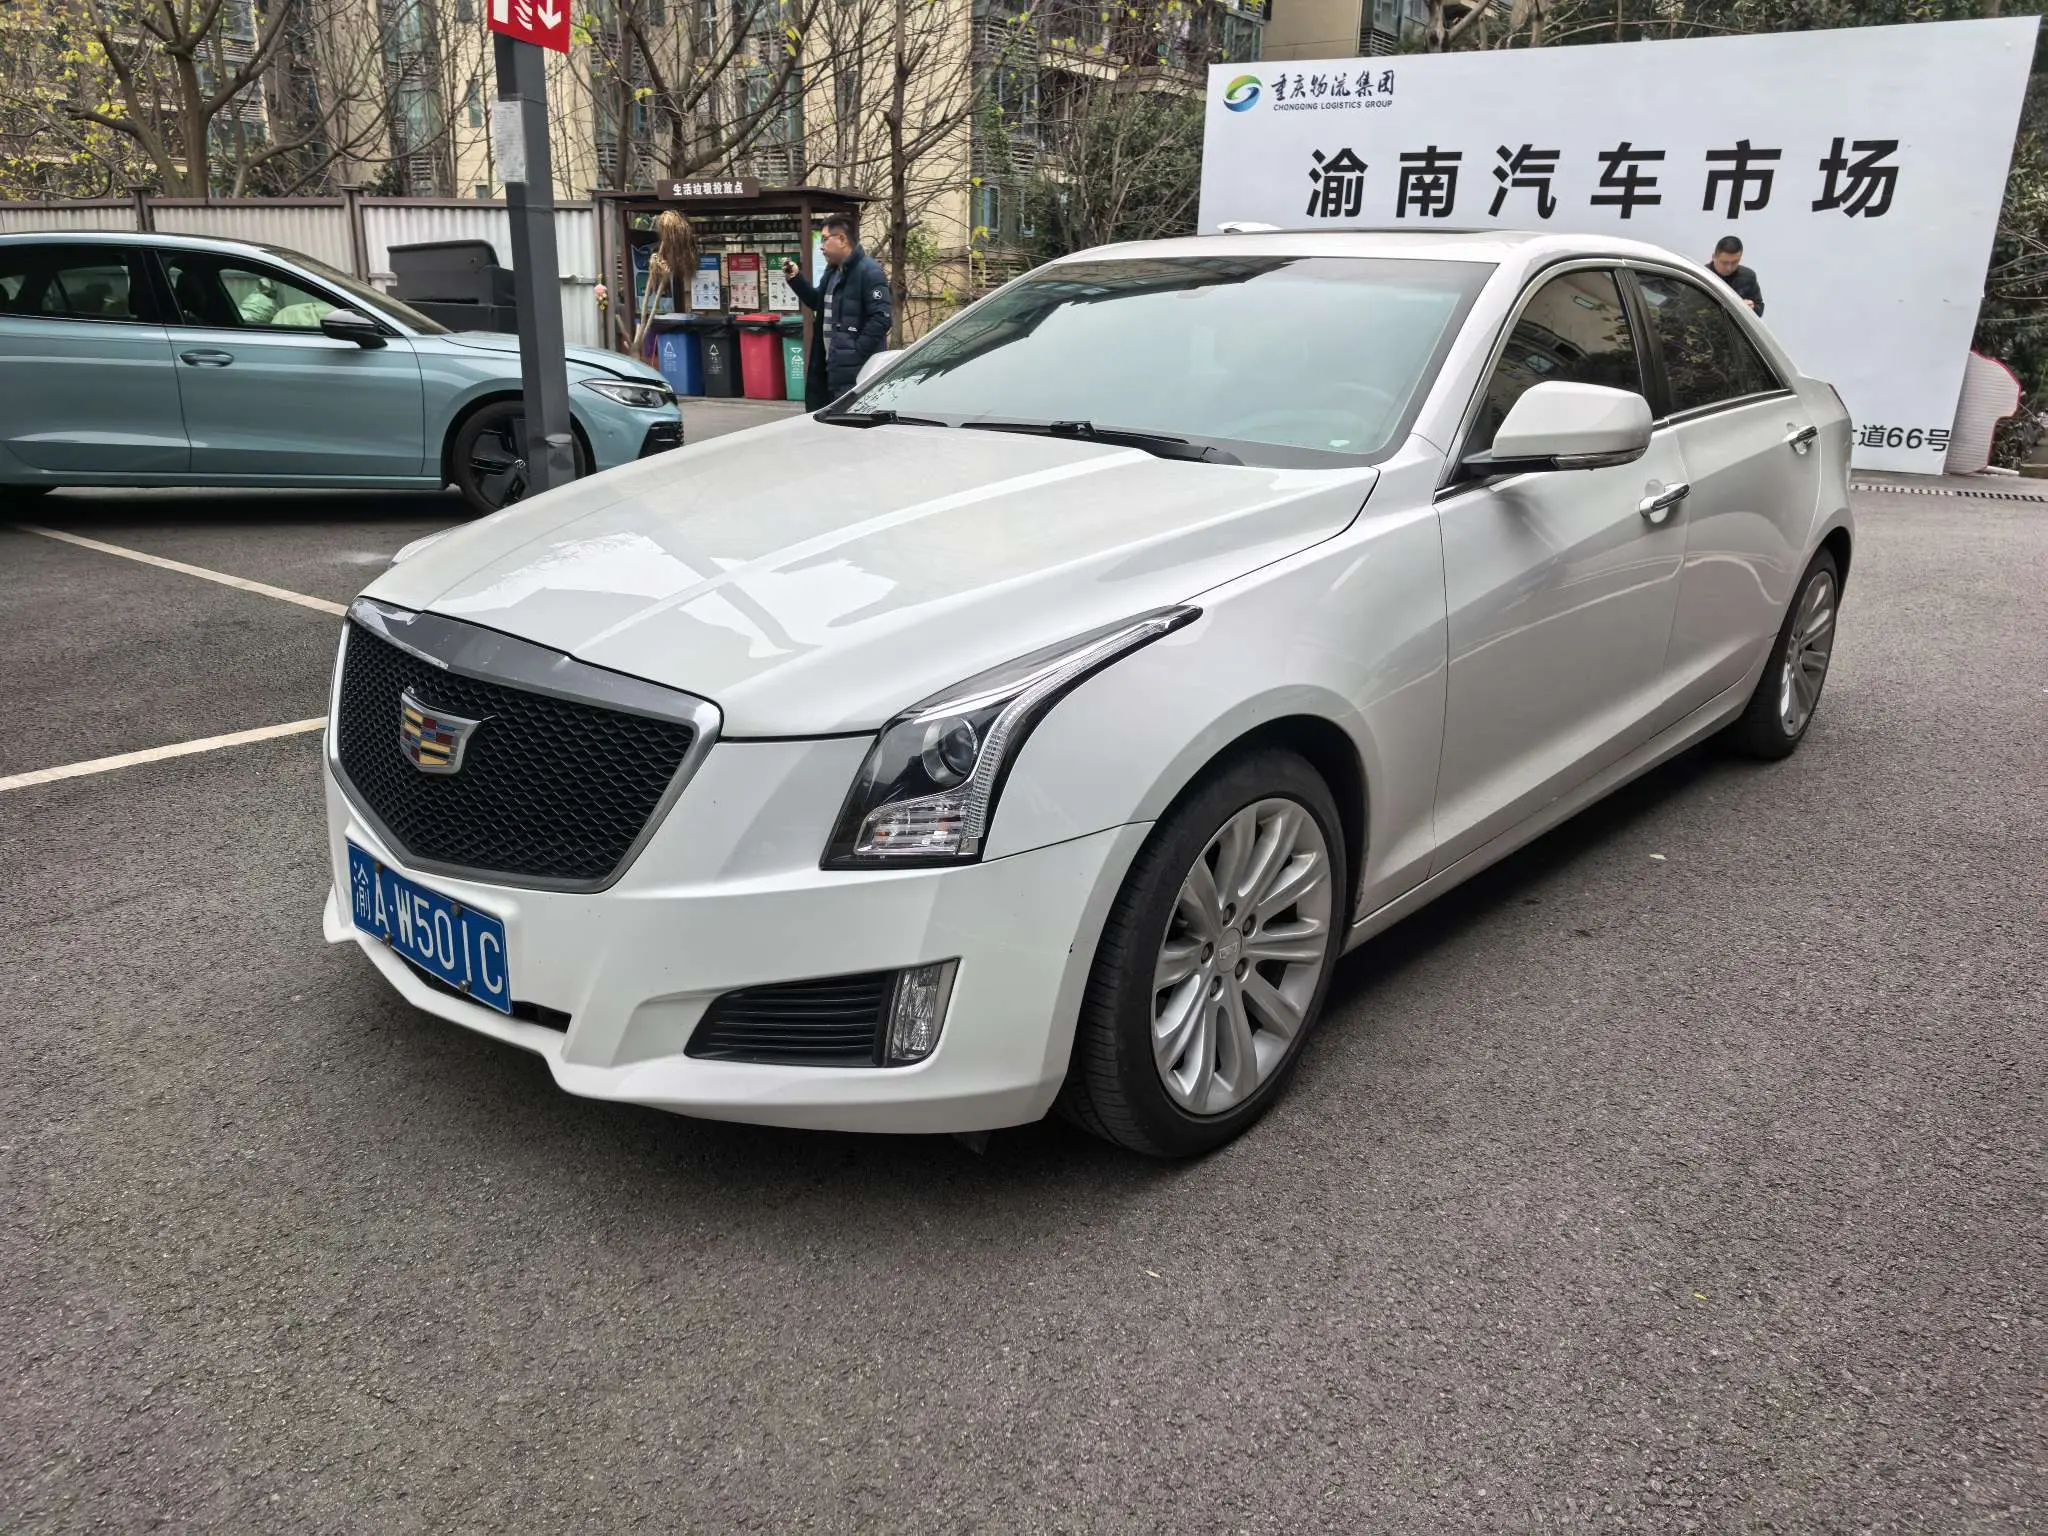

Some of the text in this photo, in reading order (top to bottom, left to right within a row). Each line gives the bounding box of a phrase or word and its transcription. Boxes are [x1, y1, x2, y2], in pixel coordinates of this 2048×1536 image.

[1271, 69, 1395, 101] 重庆物流集团
[1273, 100, 1393, 111] CHONGQING LOGISTICS GROUP
[673, 181, 744, 196] 生活垃圾投放点
[1306, 136, 1899, 220] 渝南汽车市场
[1852, 424, 1951, 452] 道66号
